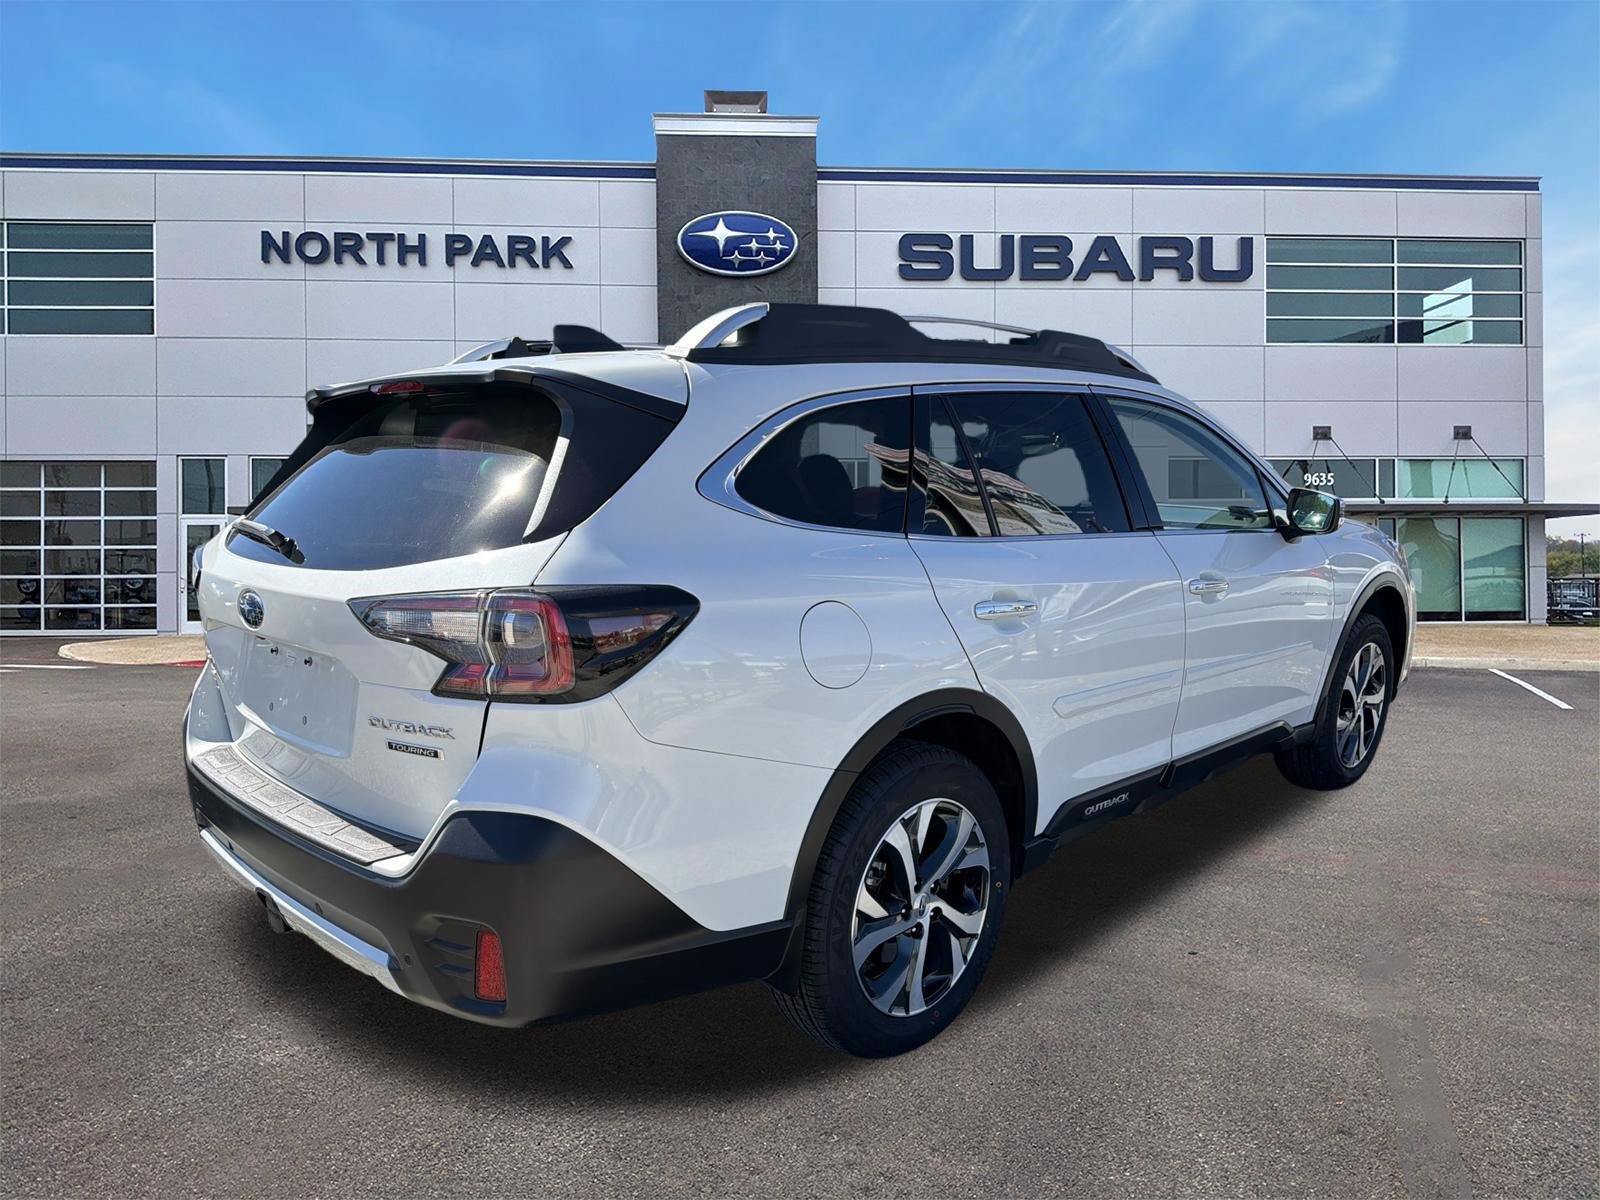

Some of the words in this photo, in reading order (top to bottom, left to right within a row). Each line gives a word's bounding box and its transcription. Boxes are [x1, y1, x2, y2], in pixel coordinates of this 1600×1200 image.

[260, 230, 427, 266] NORTH
[444, 233, 574, 269] PARK
[898, 233, 1254, 282] SUBARU
[1303, 472, 1335, 486] 9635
[368, 716, 456, 740] OUTBACK
[390, 743, 435, 757] TOURING
[1084, 792, 1130, 816] OUTBACK
